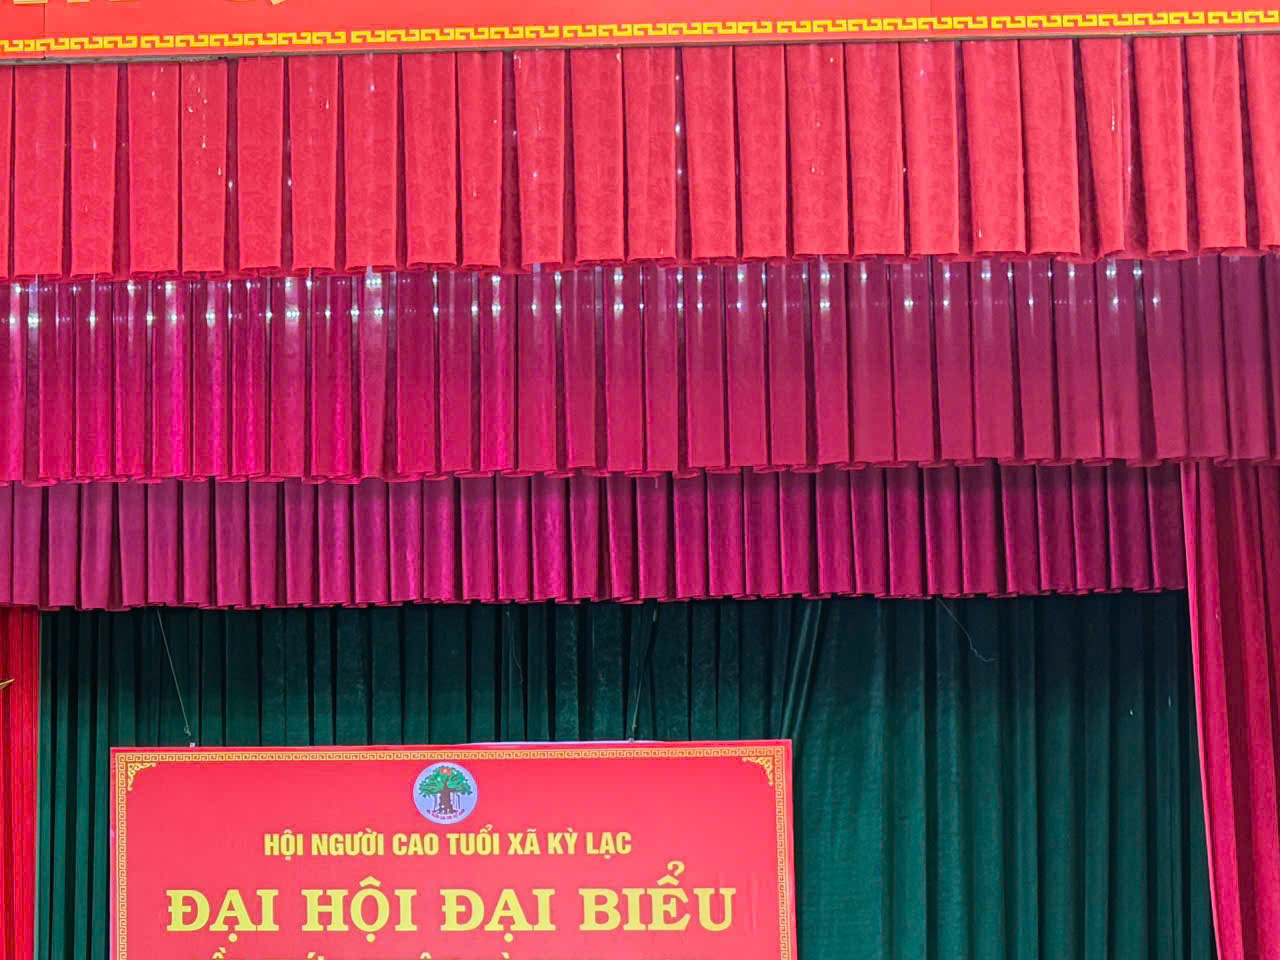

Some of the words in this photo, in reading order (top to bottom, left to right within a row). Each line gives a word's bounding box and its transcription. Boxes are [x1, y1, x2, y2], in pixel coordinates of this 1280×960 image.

[263, 831, 304, 860] HỘI
[311, 829, 385, 857] NGƯỜI
[391, 832, 440, 857] CAO
[446, 825, 501, 856] TUỔI
[507, 831, 541, 856] XÃ
[547, 831, 578, 855] KỲ
[585, 831, 633, 858] LẠC
[166, 888, 280, 943] ĐẠI
[301, 876, 418, 943] HỘI
[440, 887, 556, 943] ĐẠI
[578, 860, 737, 932] BIỂU
